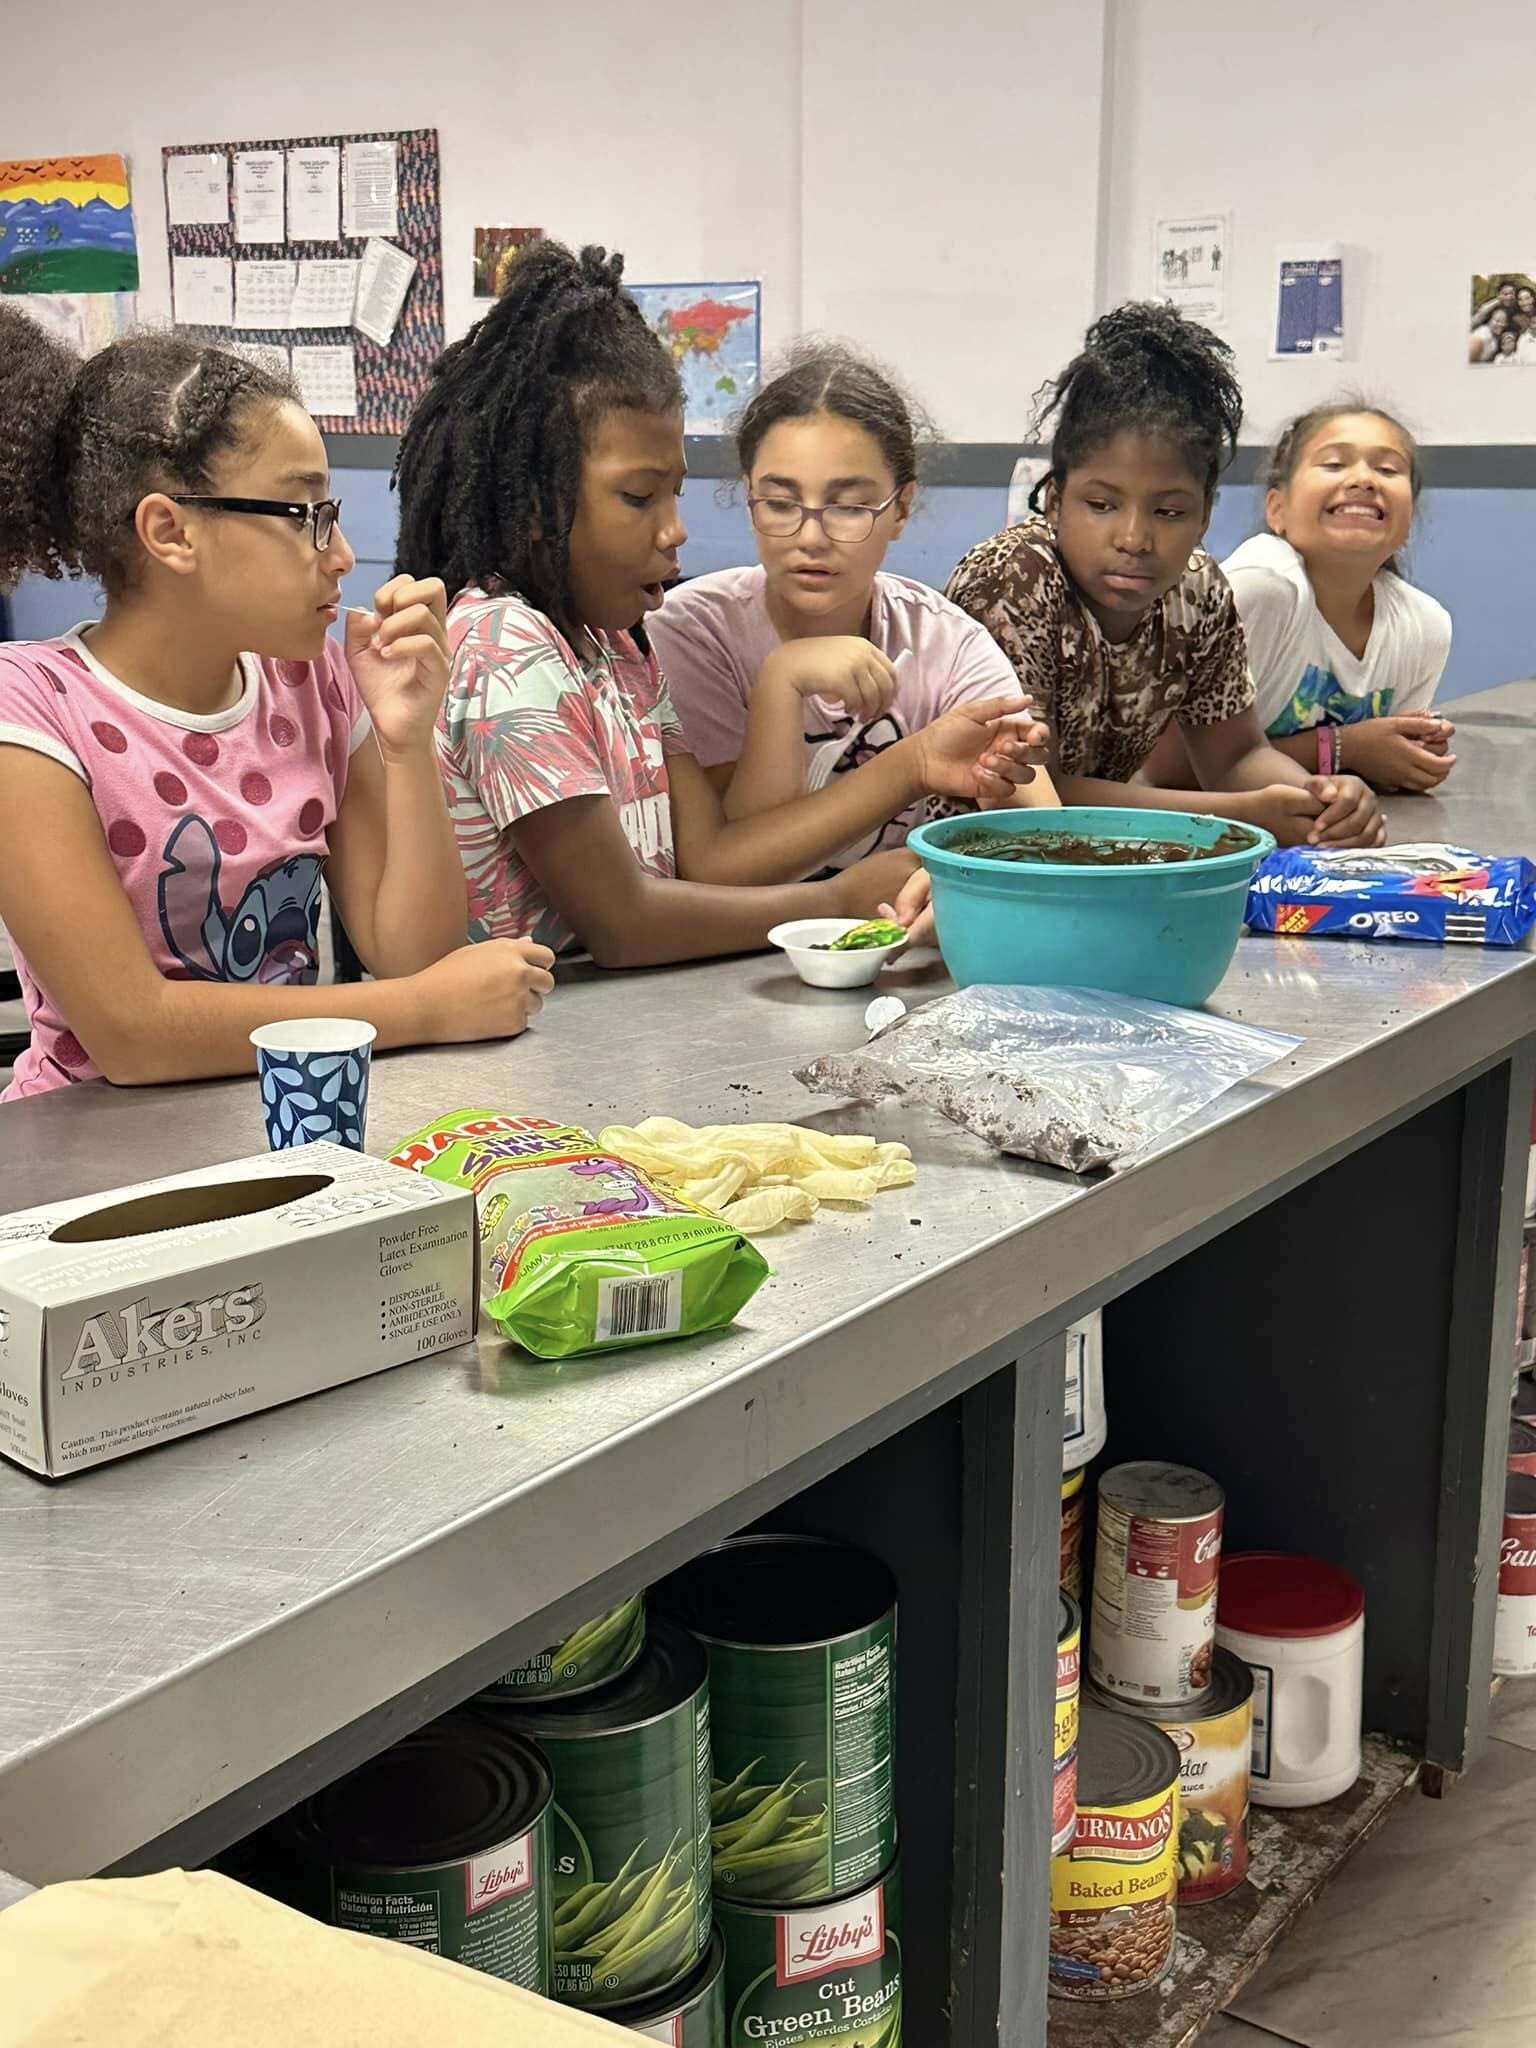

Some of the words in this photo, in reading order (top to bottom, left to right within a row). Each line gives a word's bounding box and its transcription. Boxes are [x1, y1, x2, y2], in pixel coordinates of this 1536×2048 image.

[1349, 911, 1419, 928] OREO
[389, 1116, 563, 1171] HARIB
[470, 1134, 546, 1147] TWIN
[462, 1135, 583, 1175] SNAKES
[380, 1231, 416, 1248] Powder
[418, 1224, 440, 1237] Free
[380, 1249, 407, 1263] Latex
[409, 1230, 469, 1254] Examination
[658, 1236, 671, 1244] OZ
[380, 1261, 413, 1277] Gloves
[389, 1282, 441, 1305] DISPOSABLE
[389, 1298, 458, 1328] AMBIDEXTROUS
[389, 1323, 421, 1339] SINGLE
[422, 1315, 439, 1328] USE
[440, 1309, 462, 1323] ONLY
[61, 1282, 267, 1381] Akers
[226, 1330, 262, 1348] INC
[417, 1335, 436, 1352] 100
[438, 1328, 469, 1344] Gloves
[100, 1430, 118, 1440] This
[120, 1418, 150, 1435] product
[151, 1409, 183, 1424] contains
[185, 1398, 210, 1413] natural
[212, 1391, 237, 1405] rubber
[61, 1447, 88, 1461] which
[90, 1443, 107, 1453] may
[108, 1436, 130, 1448] cause
[131, 1425, 160, 1440] allergic
[1076, 1803, 1171, 1841] URMANO'S
[475, 1860, 525, 1898] Libby's
[1069, 1881, 1123, 1898] Baked
[1129, 1870, 1168, 1893] Beans
[340, 1891, 383, 1905] Nutrition
[385, 1896, 414, 1905] Facts
[340, 1901, 368, 1913] Datos
[370, 1904, 383, 1914] de
[385, 1902, 433, 1915] Nutrición
[792, 1914, 874, 1963] Libby's
[570, 1964, 592, 1977] NETO
[818, 1978, 857, 2000] Cut
[743, 2006, 834, 2039] Green
[842, 1973, 901, 2020] Beans
[808, 2017, 851, 2039] Verdes
